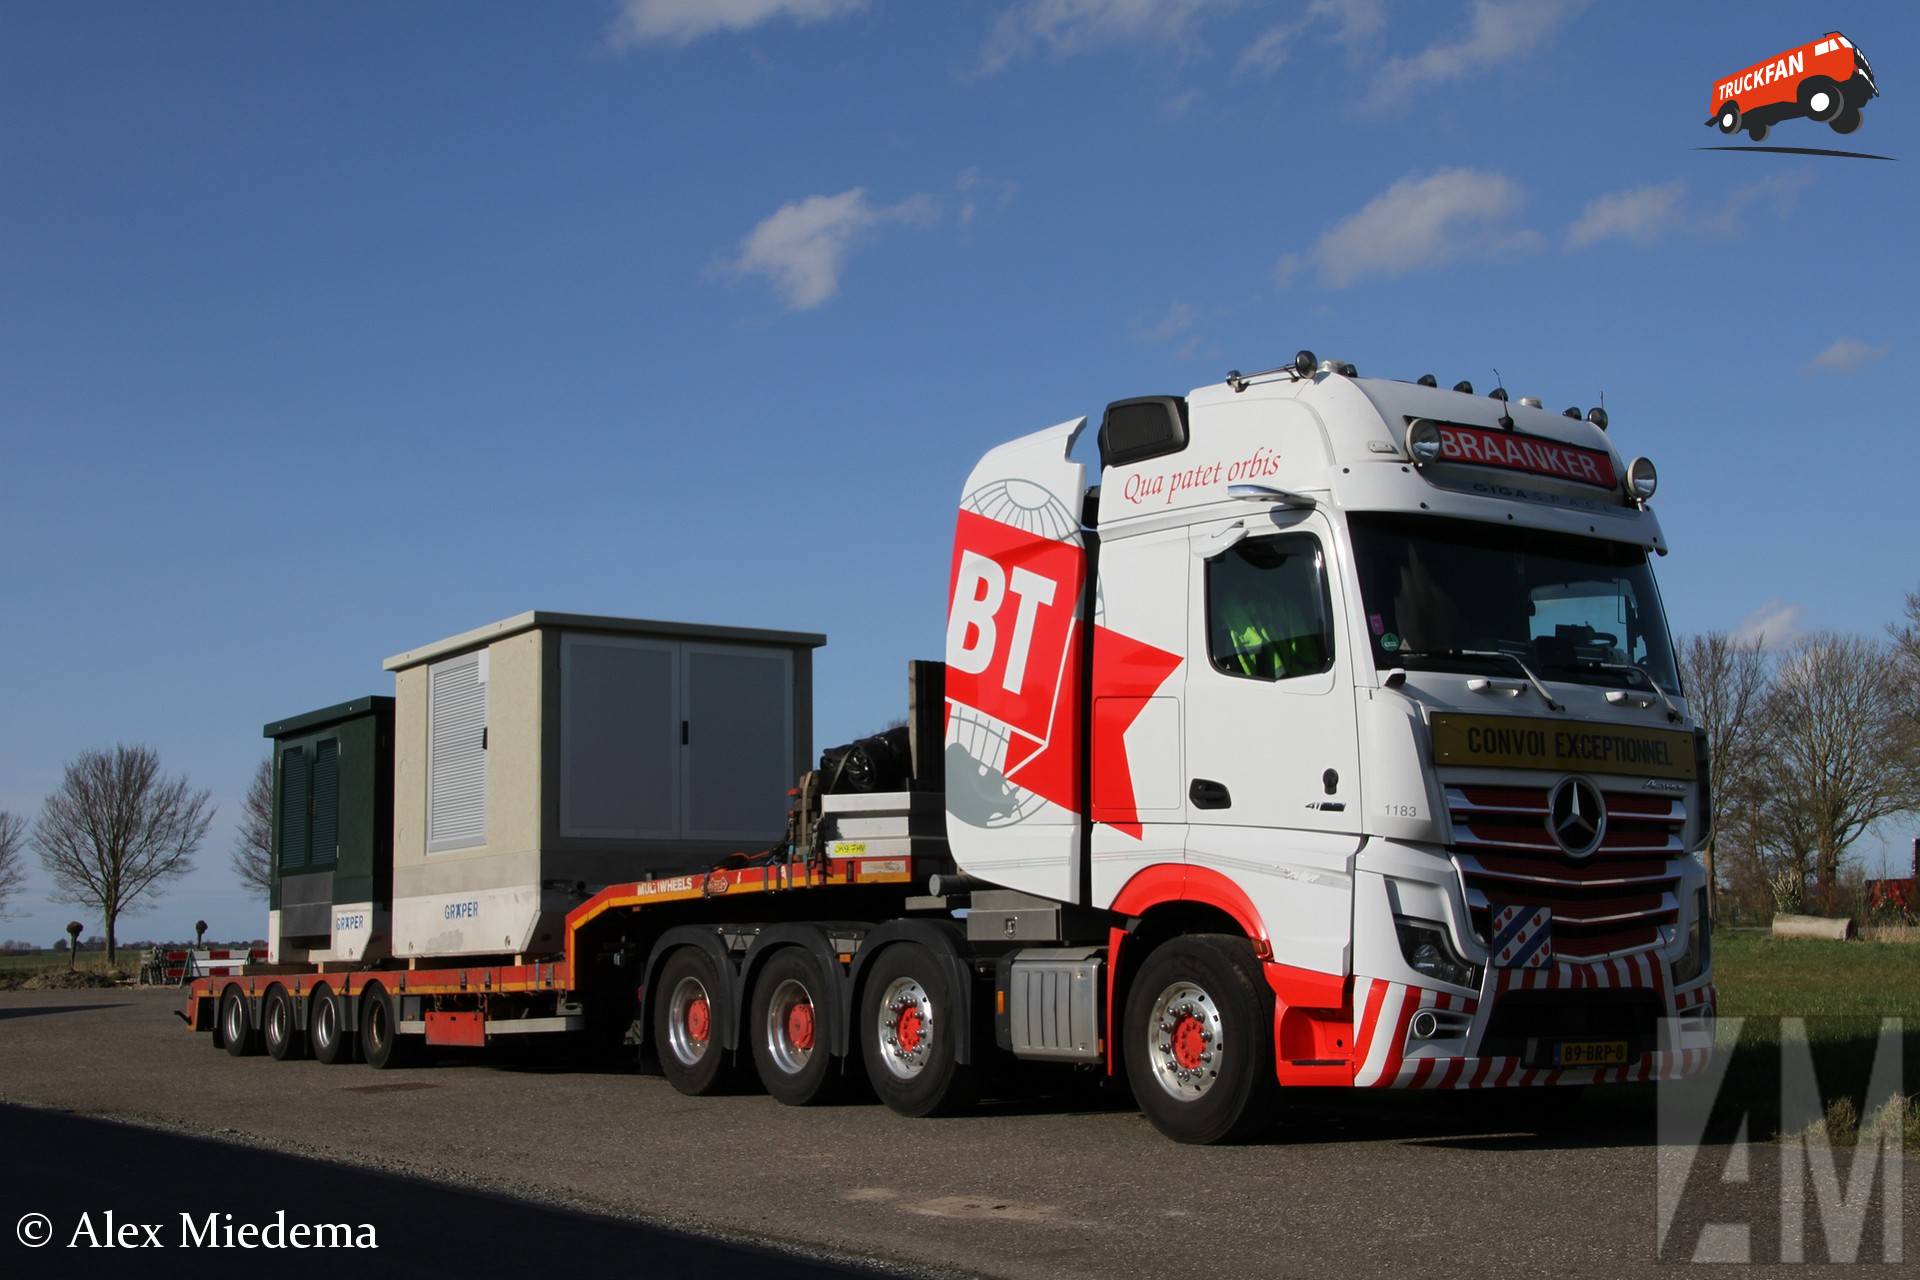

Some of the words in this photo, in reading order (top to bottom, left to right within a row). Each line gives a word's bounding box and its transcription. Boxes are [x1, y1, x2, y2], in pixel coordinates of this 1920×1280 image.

[1124, 473, 1164, 504] Qua
[1166, 461, 1222, 504] patet
[1227, 446, 1281, 482] orbis
[1440, 430, 1601, 481] BRAANKER
[946, 549, 1058, 696] BT
[1467, 727, 1546, 757] CONVOI
[1554, 731, 1674, 767] EXCEPTIONNEL
[1384, 804, 1417, 818] 1183
[1564, 1043, 1625, 1062] 89-BRP-8
